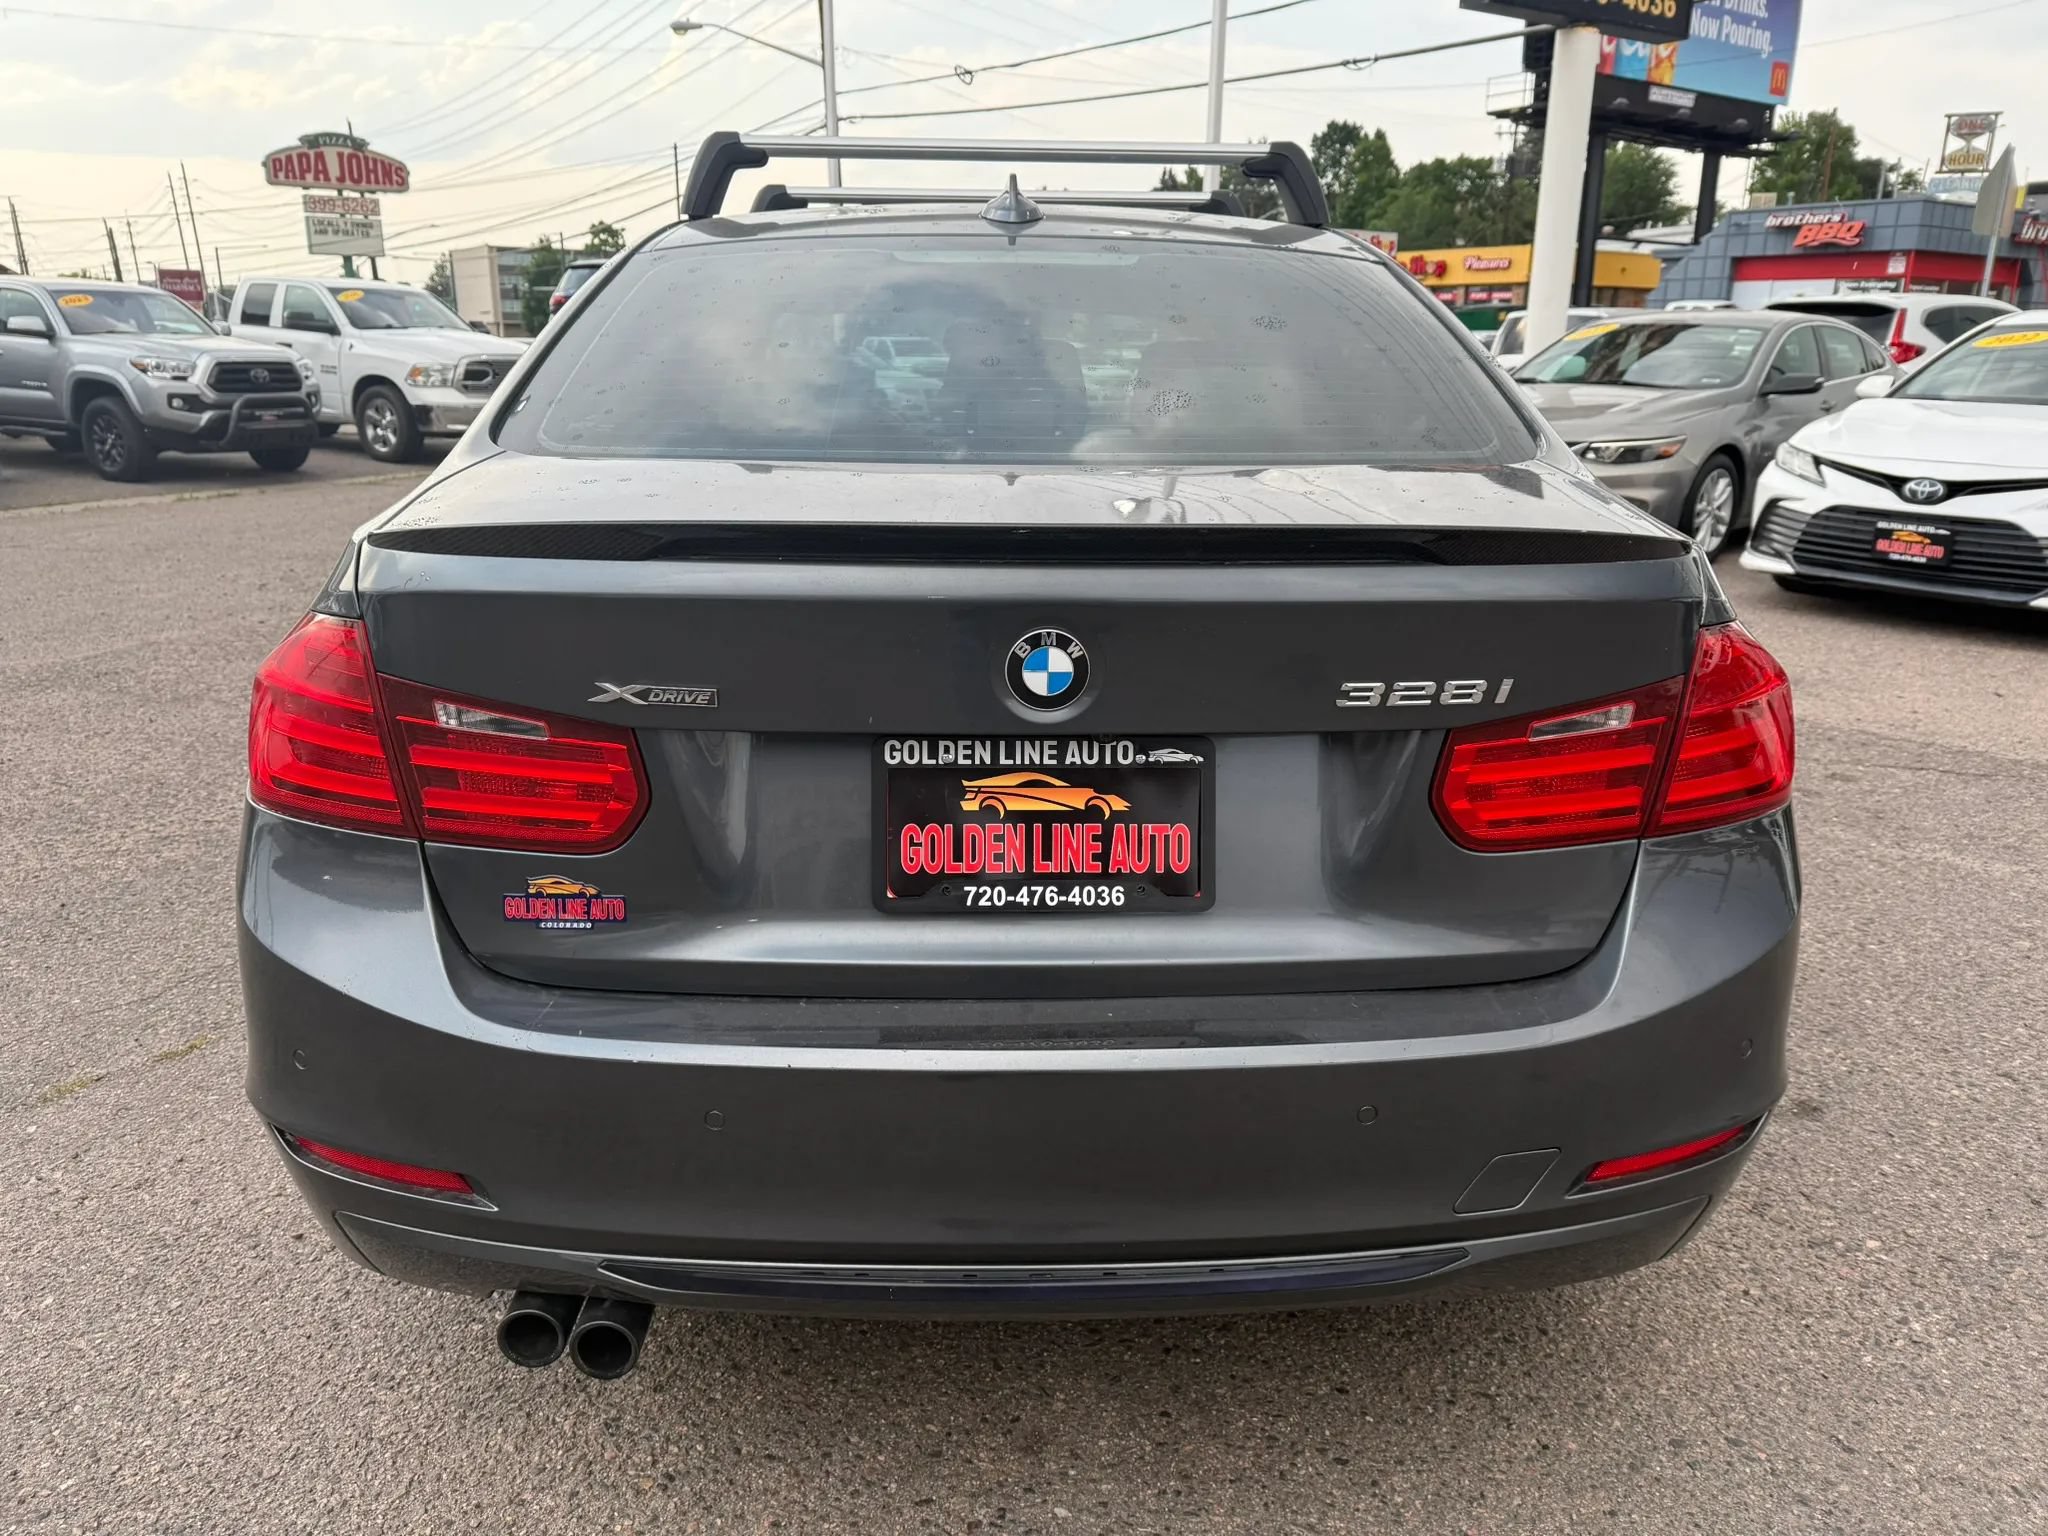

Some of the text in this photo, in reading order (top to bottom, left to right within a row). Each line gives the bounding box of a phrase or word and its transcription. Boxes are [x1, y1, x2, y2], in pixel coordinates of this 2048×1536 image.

[1690, 8, 1719, 40] Now
[1722, 14, 1774, 58] Pouring.
[271, 151, 406, 187] PAPA JOHNS
[1948, 152, 1985, 167] HOUR
[308, 197, 378, 213] 399-6262
[1793, 221, 1866, 248] BBQ
[1014, 631, 1084, 659] BMW
[884, 739, 991, 765] GOLDEN
[999, 740, 1059, 765] LINE
[900, 823, 1191, 874] GOLDEN LINE AUTO
[504, 897, 625, 920] GOLDEN LINE AUTO
[963, 885, 1125, 906] 720-476-4036
[539, 921, 593, 929] COLORADO
